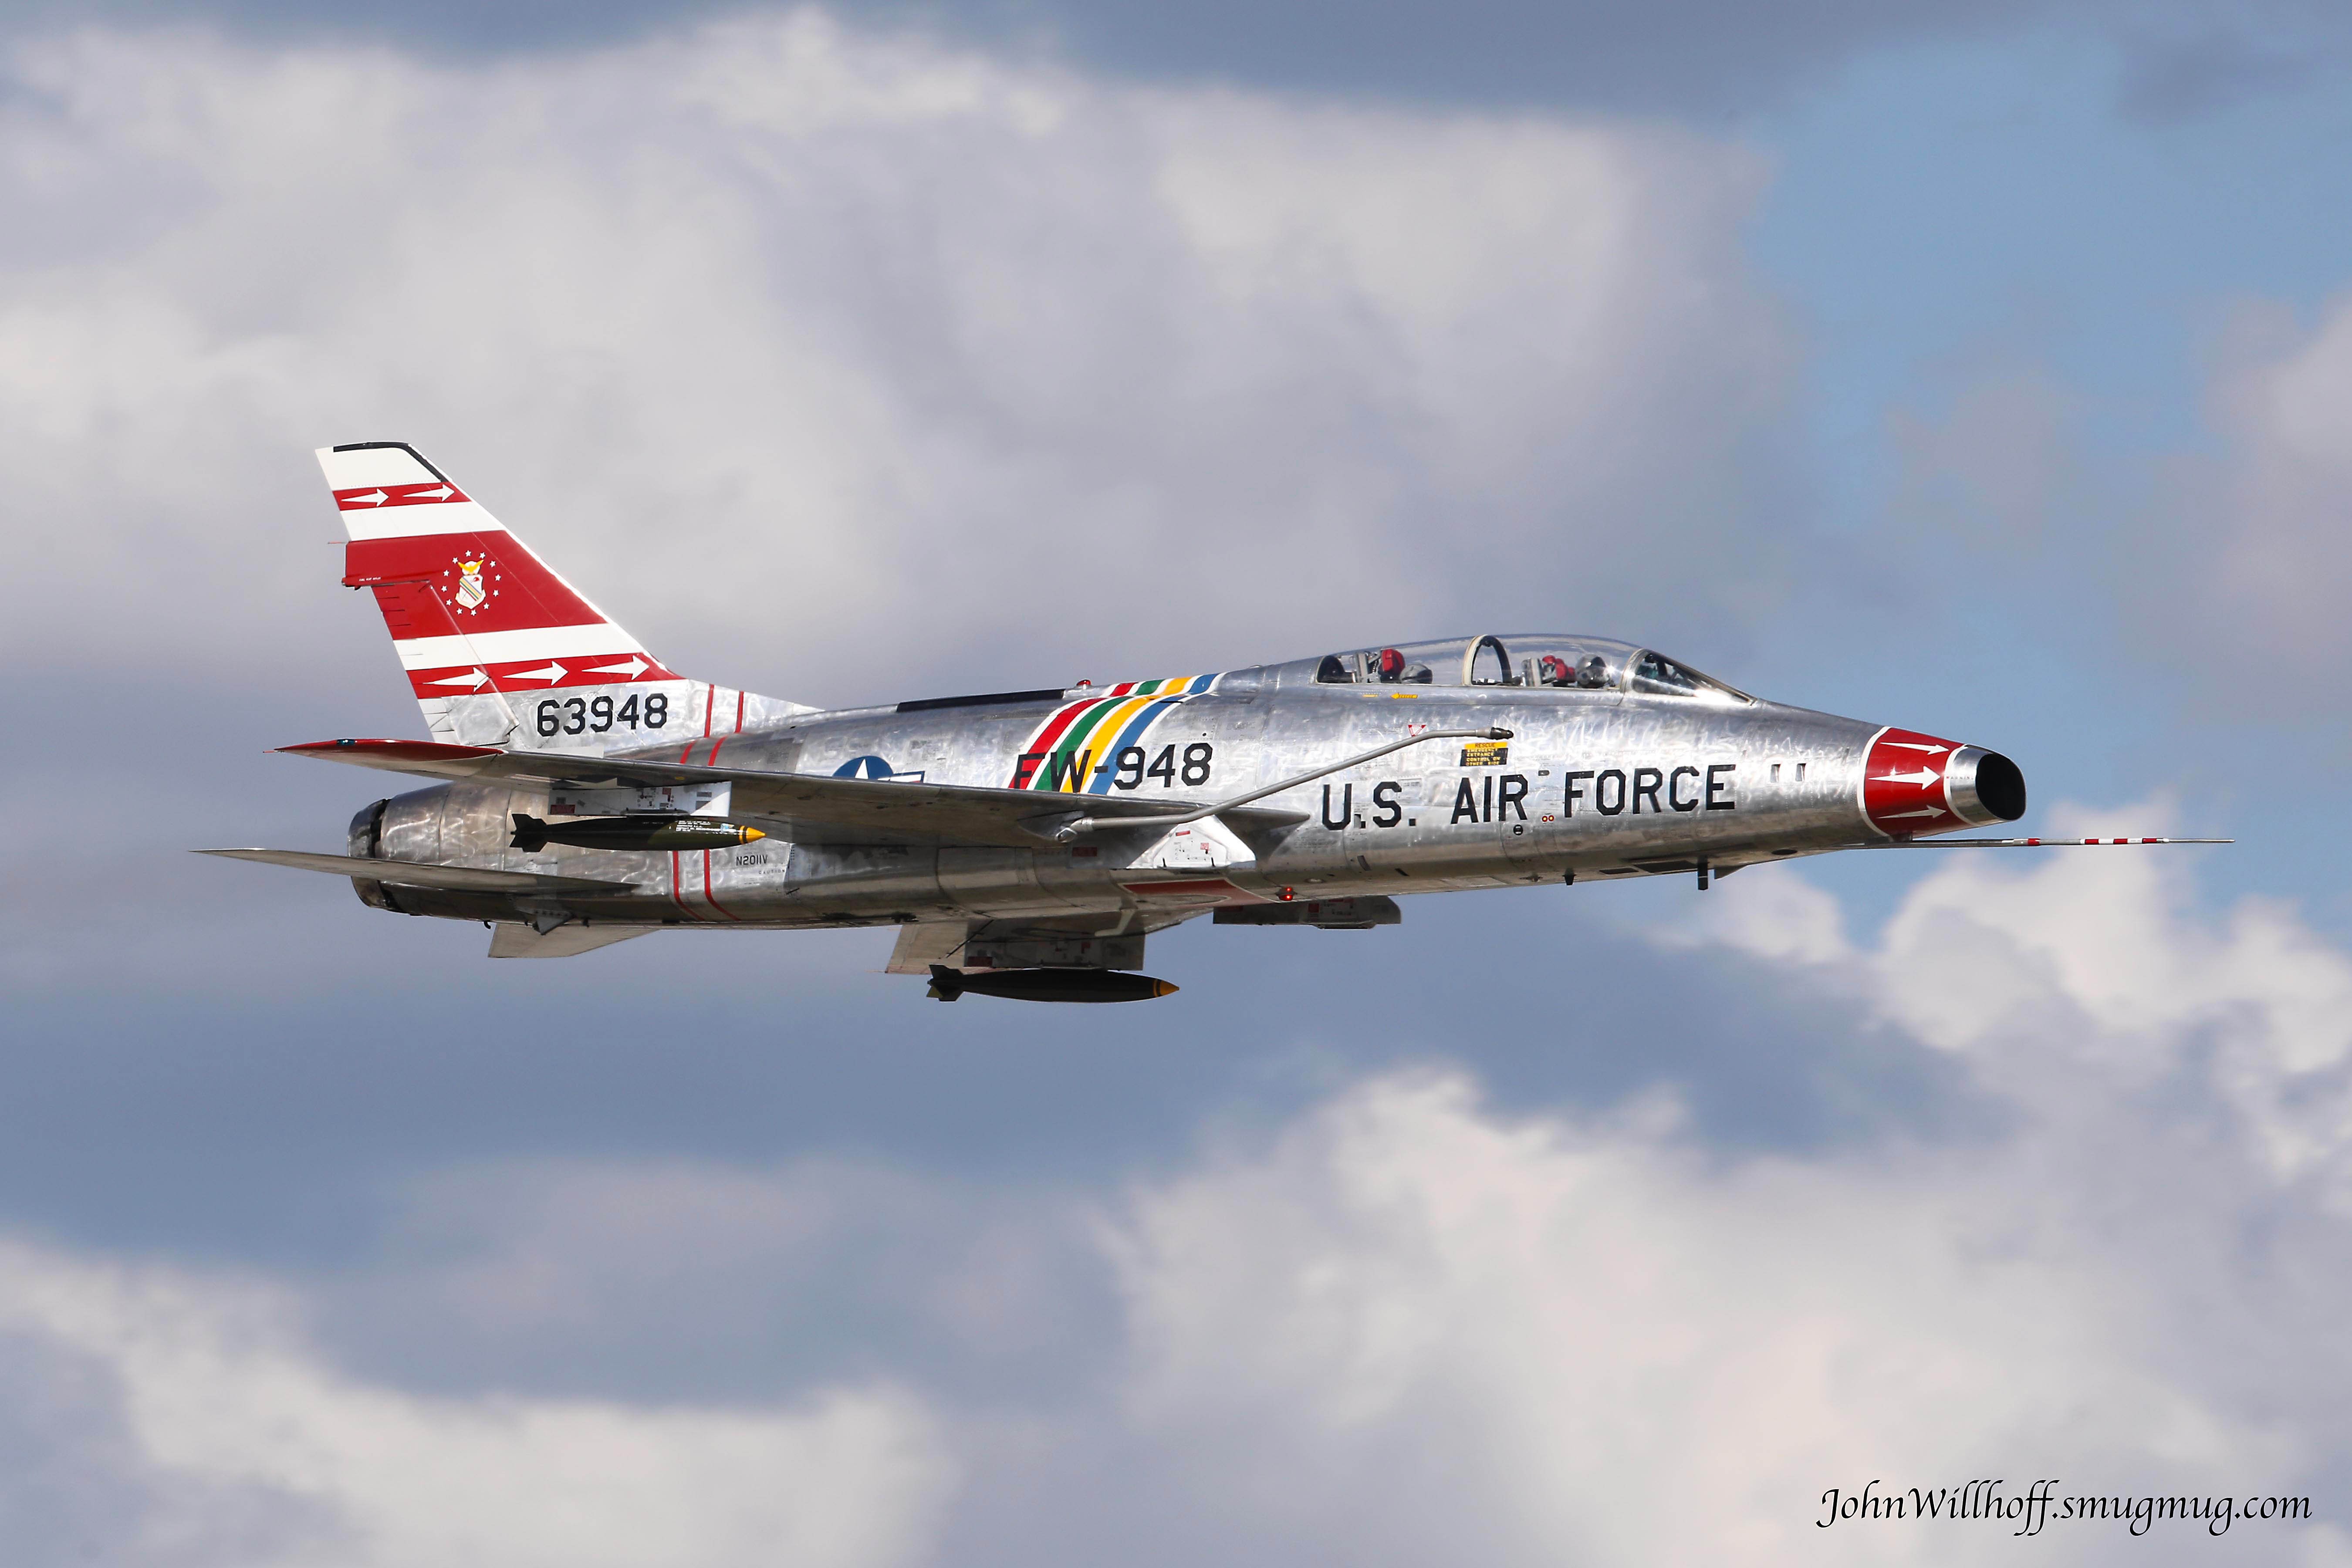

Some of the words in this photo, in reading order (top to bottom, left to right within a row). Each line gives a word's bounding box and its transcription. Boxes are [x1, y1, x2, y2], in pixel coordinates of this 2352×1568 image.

[537, 693, 668, 737] 63948
[1014, 743, 1213, 793] FW-948
[1322, 781, 1416, 831] U.S.
[1450, 774, 1528, 825] AIR
[1565, 764, 1736, 818] FORCE
[736, 854, 768, 866] N2011V
